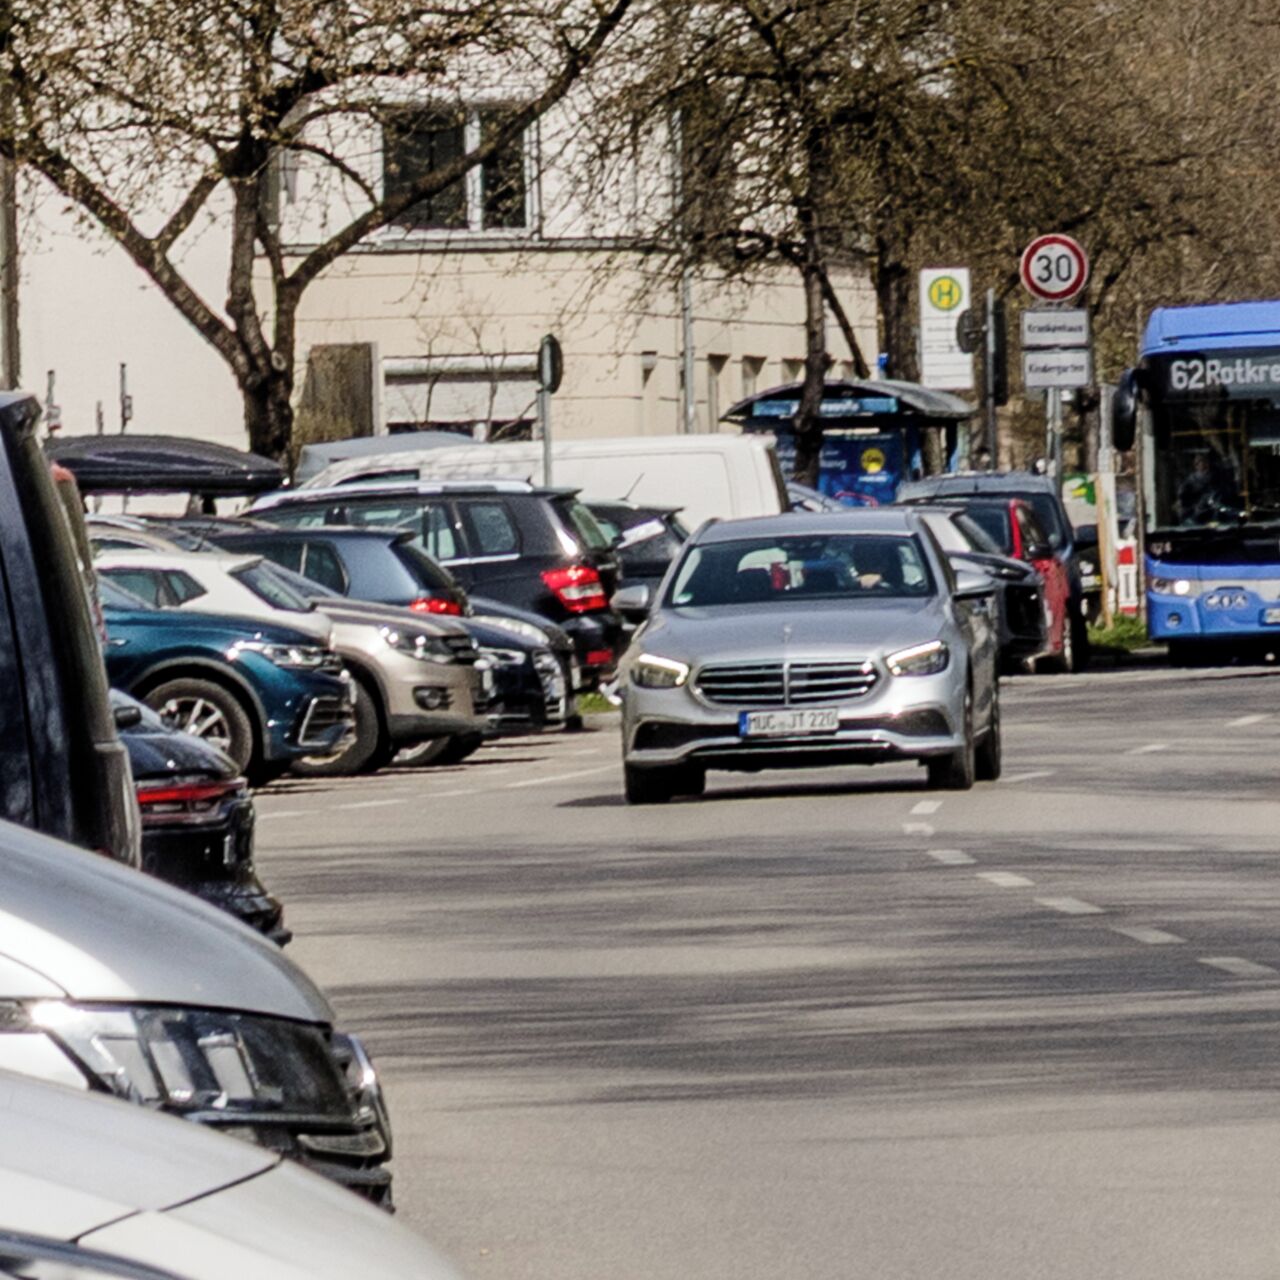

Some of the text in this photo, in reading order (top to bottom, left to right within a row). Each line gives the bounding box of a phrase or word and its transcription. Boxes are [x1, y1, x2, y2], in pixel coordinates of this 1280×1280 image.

[1037, 254, 1072, 282] 30
[938, 282, 953, 303] H
[1027, 323, 1083, 333] Krankenhaus
[1028, 363, 1085, 375] Kindergarten
[1171, 359, 1205, 389] 62
